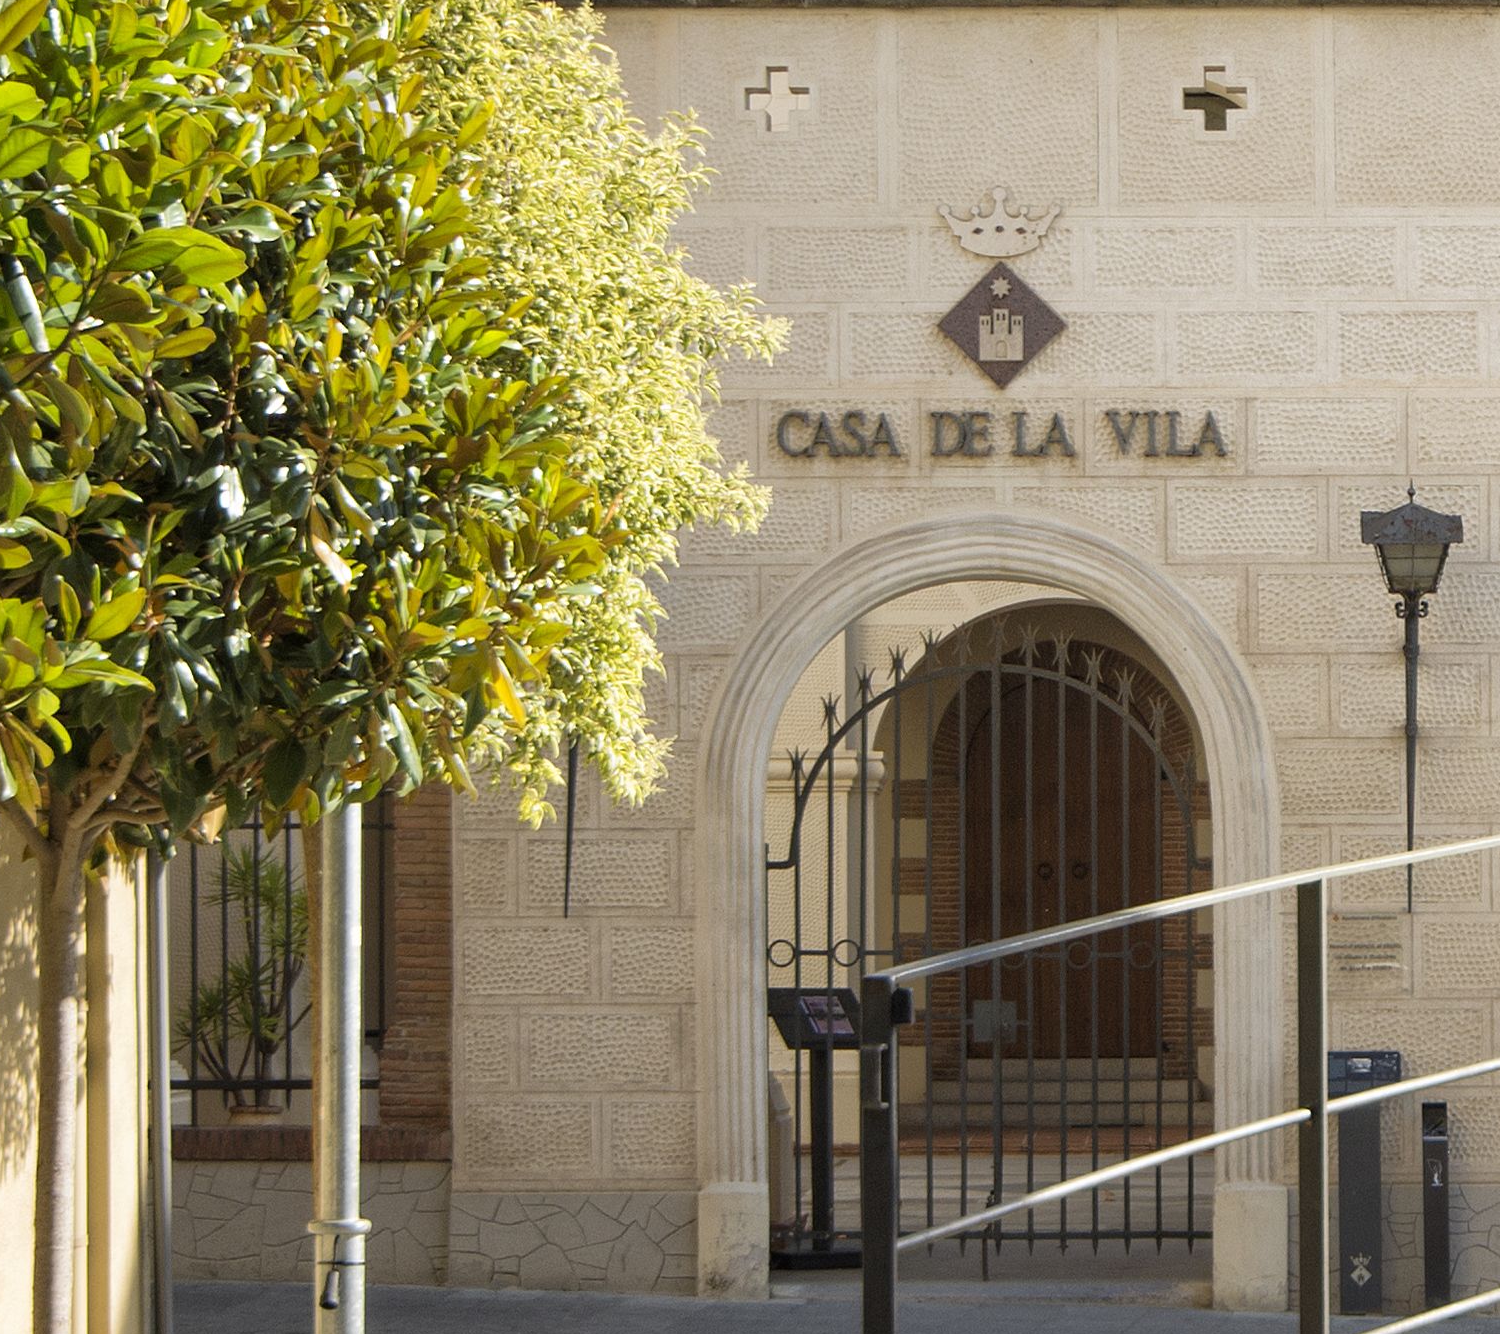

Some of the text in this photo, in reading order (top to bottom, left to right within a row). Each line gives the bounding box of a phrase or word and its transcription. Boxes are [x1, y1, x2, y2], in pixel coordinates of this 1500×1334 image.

[775, 409, 1229, 458] CASA DE LA VILA
